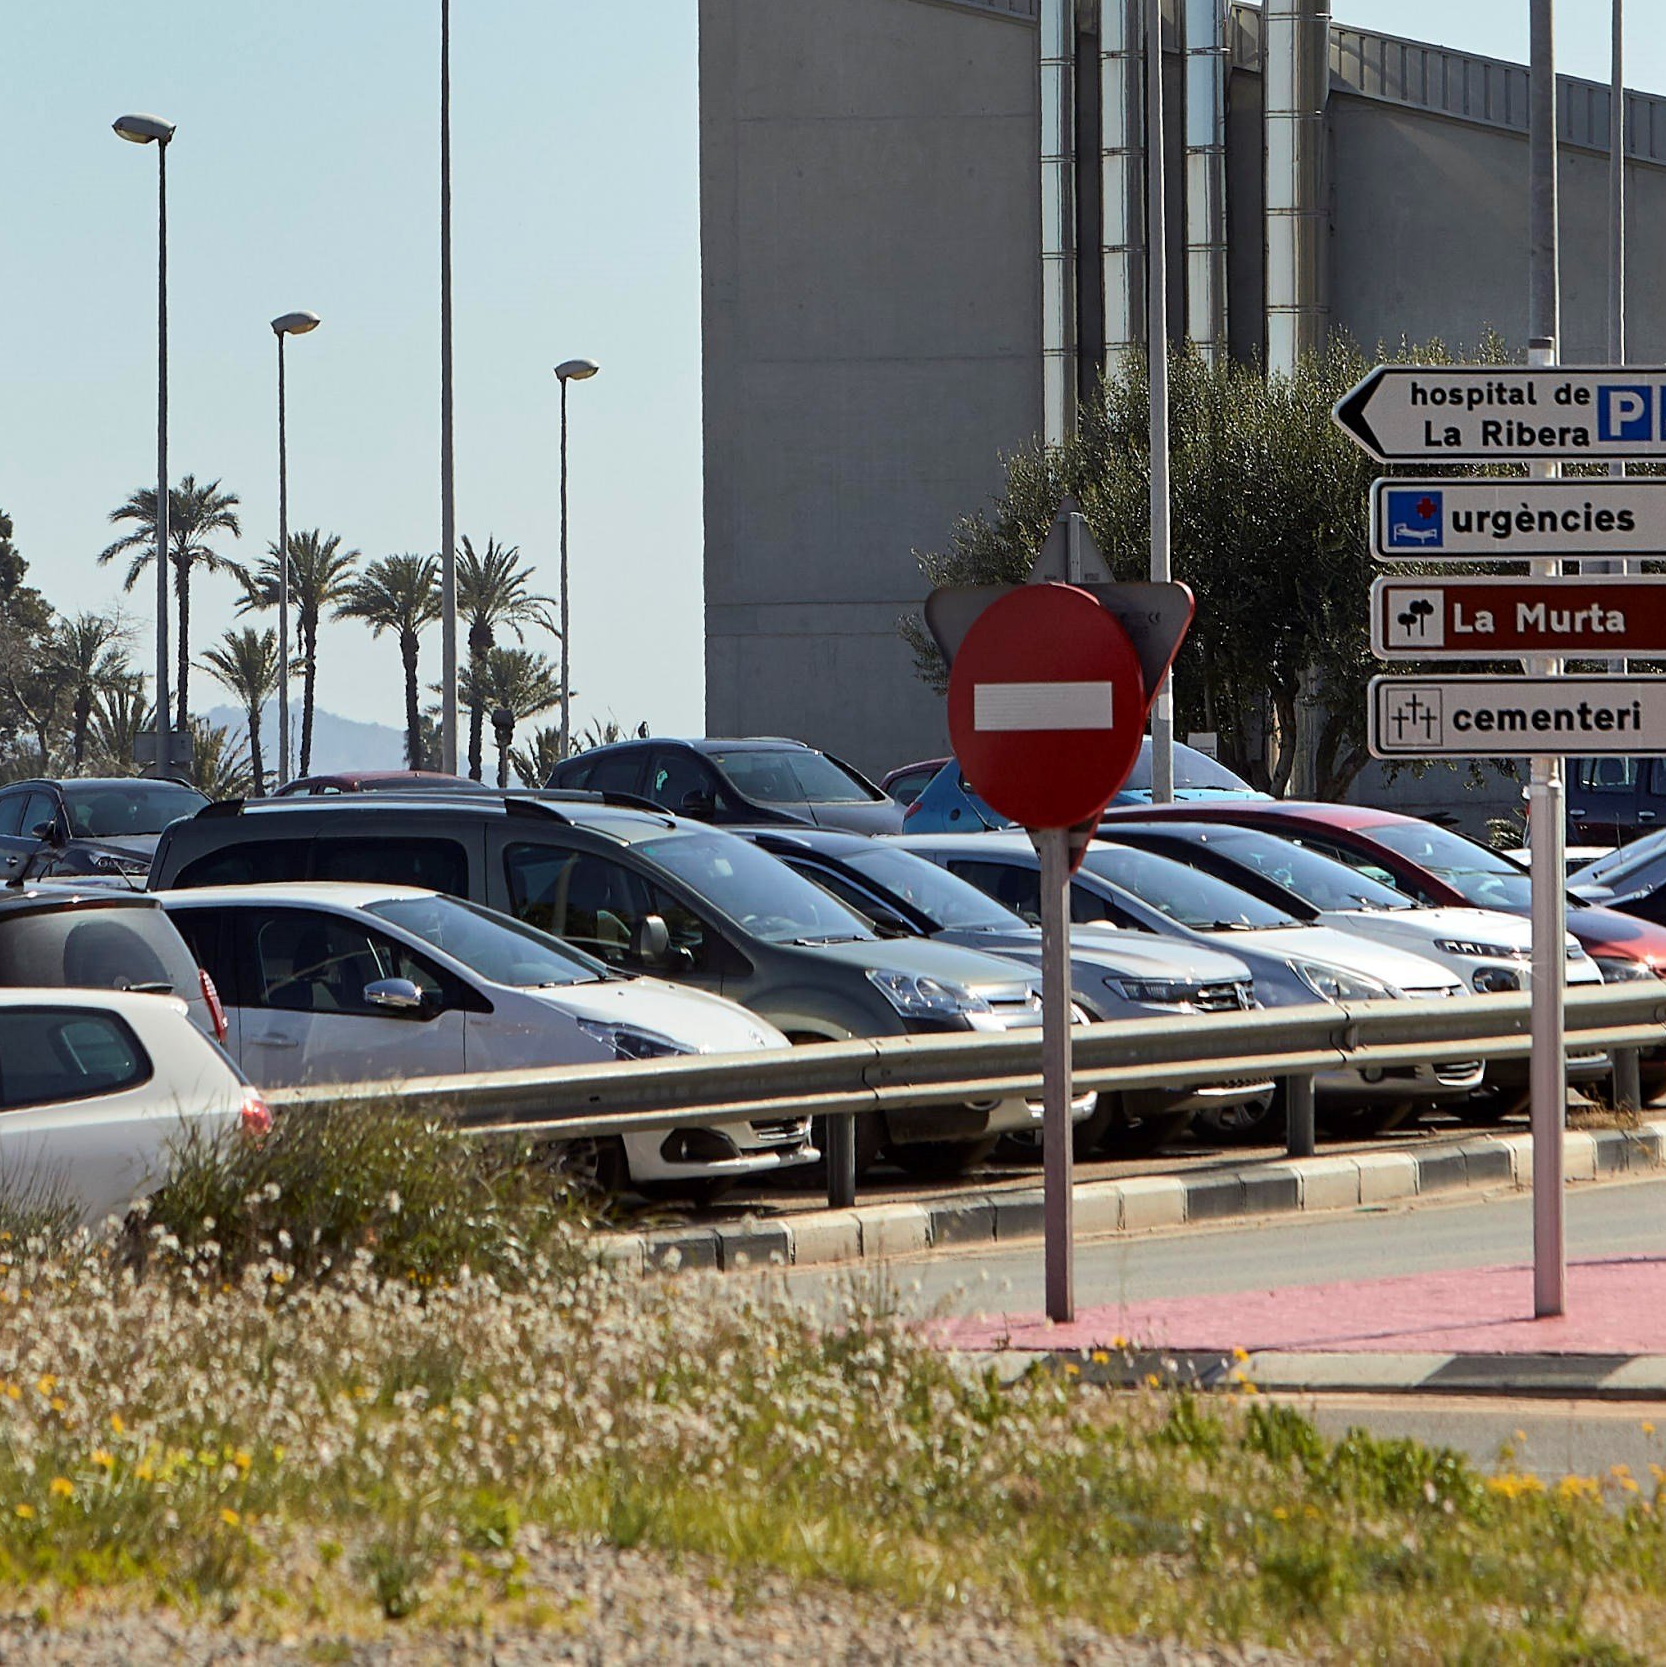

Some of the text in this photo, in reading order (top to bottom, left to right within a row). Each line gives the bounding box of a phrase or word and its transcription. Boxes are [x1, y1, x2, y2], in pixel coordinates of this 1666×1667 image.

[1412, 382, 1590, 411] hospital de
[1610, 392, 1644, 436] P
[1425, 420, 1589, 446] La Ribera
[1453, 502, 1634, 539] urgències
[1455, 603, 1625, 632] La Murta
[1453, 701, 1640, 731] cementeri
